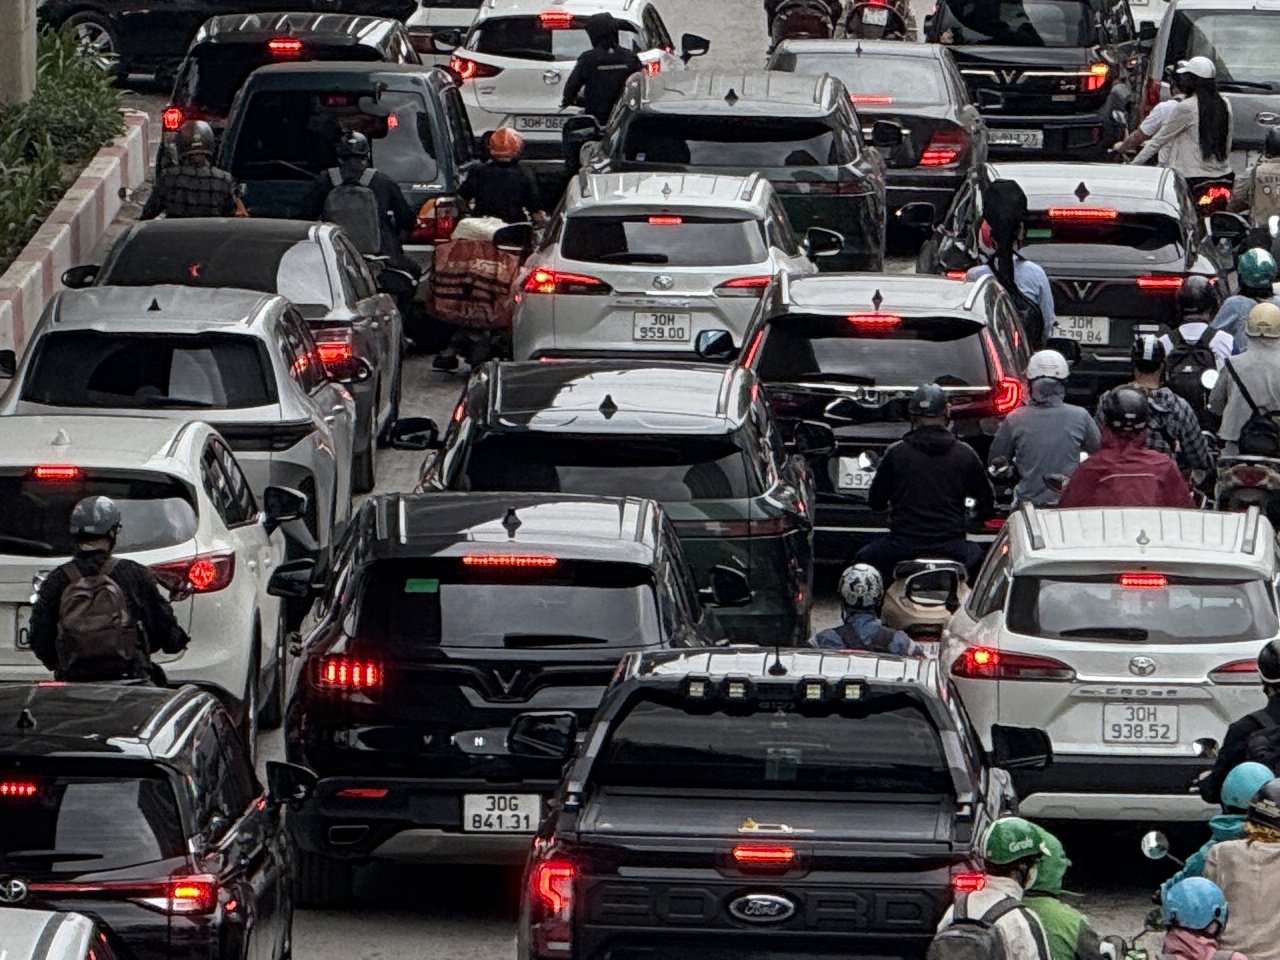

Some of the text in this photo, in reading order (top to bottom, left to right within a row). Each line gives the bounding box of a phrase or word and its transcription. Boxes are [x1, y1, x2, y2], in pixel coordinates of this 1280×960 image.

[650, 312, 676, 327] 30H
[640, 326, 685, 340] 959.00
[1125, 706, 1157, 722] 30H
[1111, 723, 1171, 740] 938.52
[485, 795, 519, 812] 30G
[472, 813, 530, 830] 841.31
[744, 898, 783, 916] Ford
